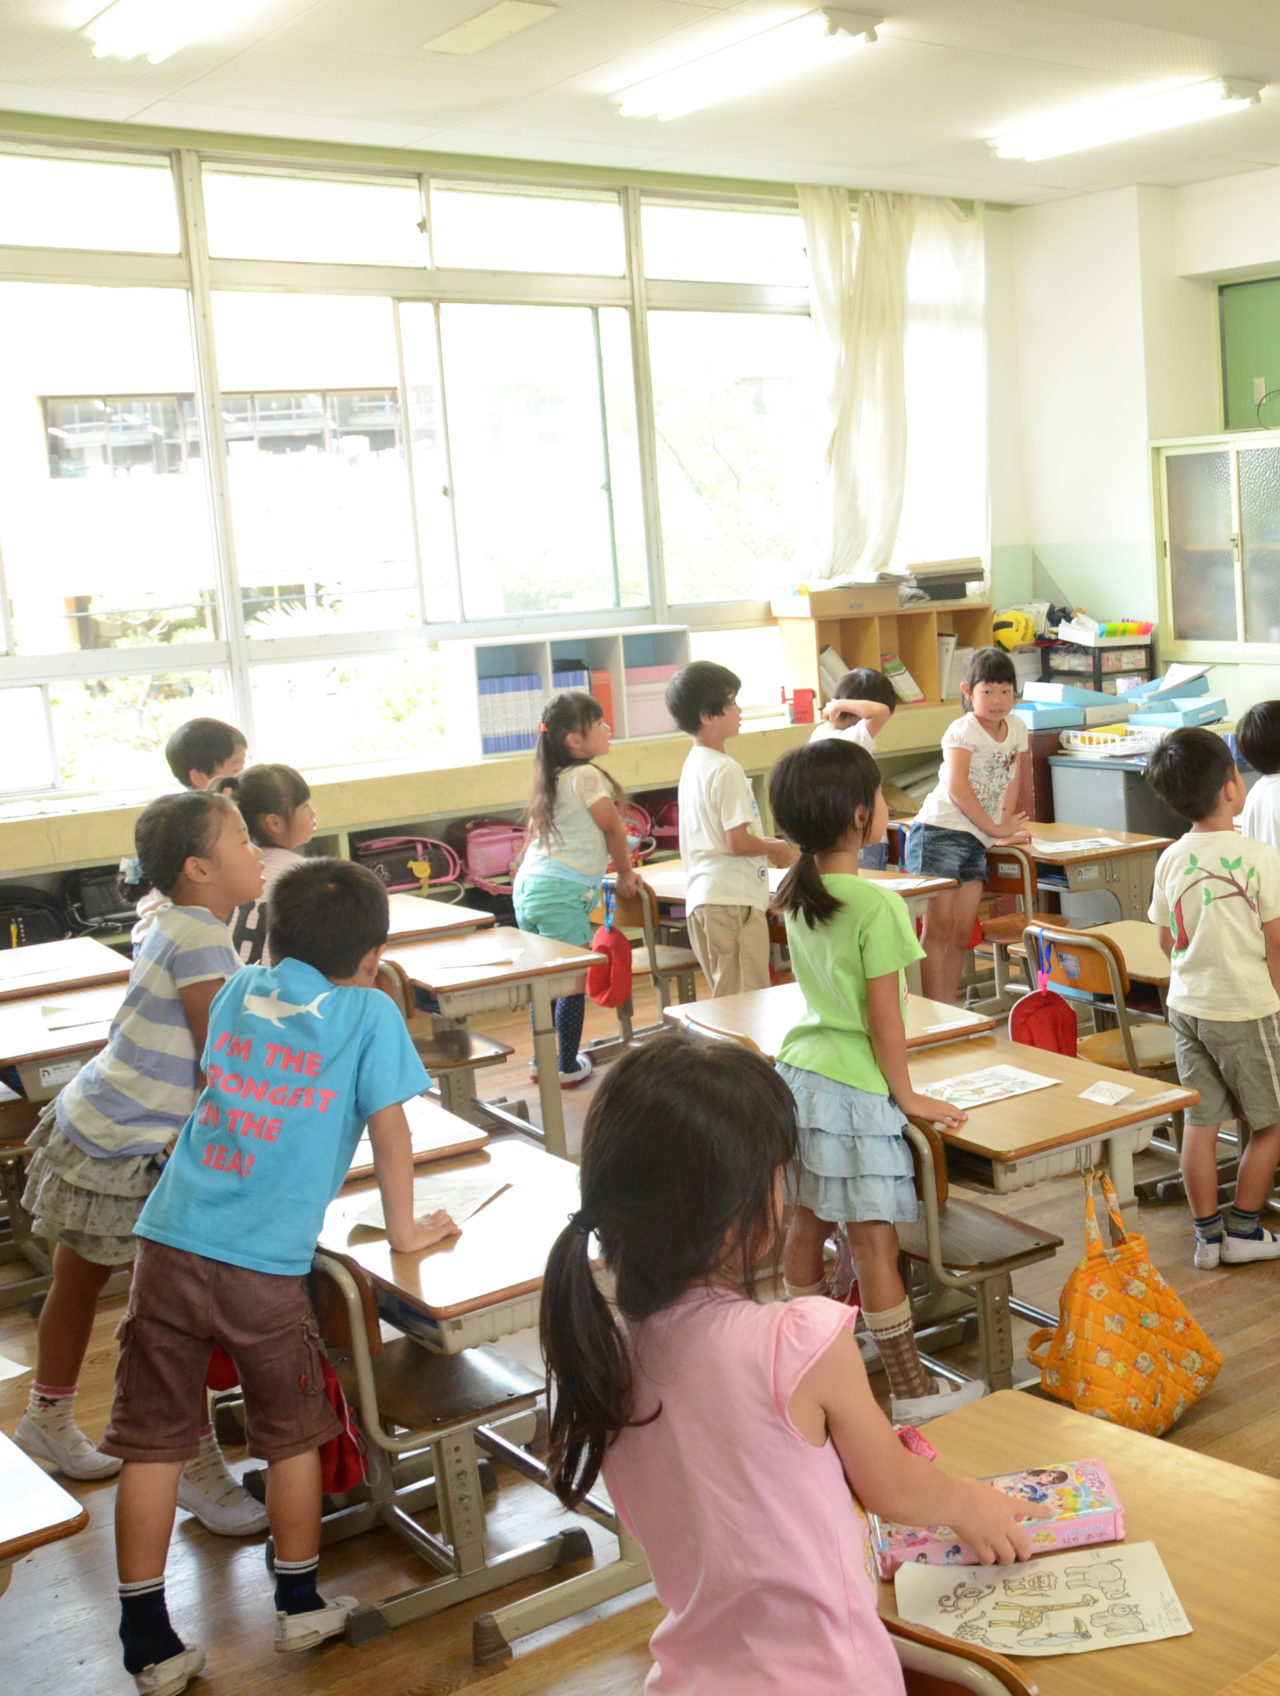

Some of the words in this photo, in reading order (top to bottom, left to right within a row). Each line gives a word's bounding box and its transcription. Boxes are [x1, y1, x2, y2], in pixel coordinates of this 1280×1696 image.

[213, 1031, 254, 1061] I'M
[264, 1043, 325, 1077] THE
[198, 1100, 220, 1129] IN
[226, 1108, 283, 1142] THE
[200, 1143, 256, 1177] SEA!
